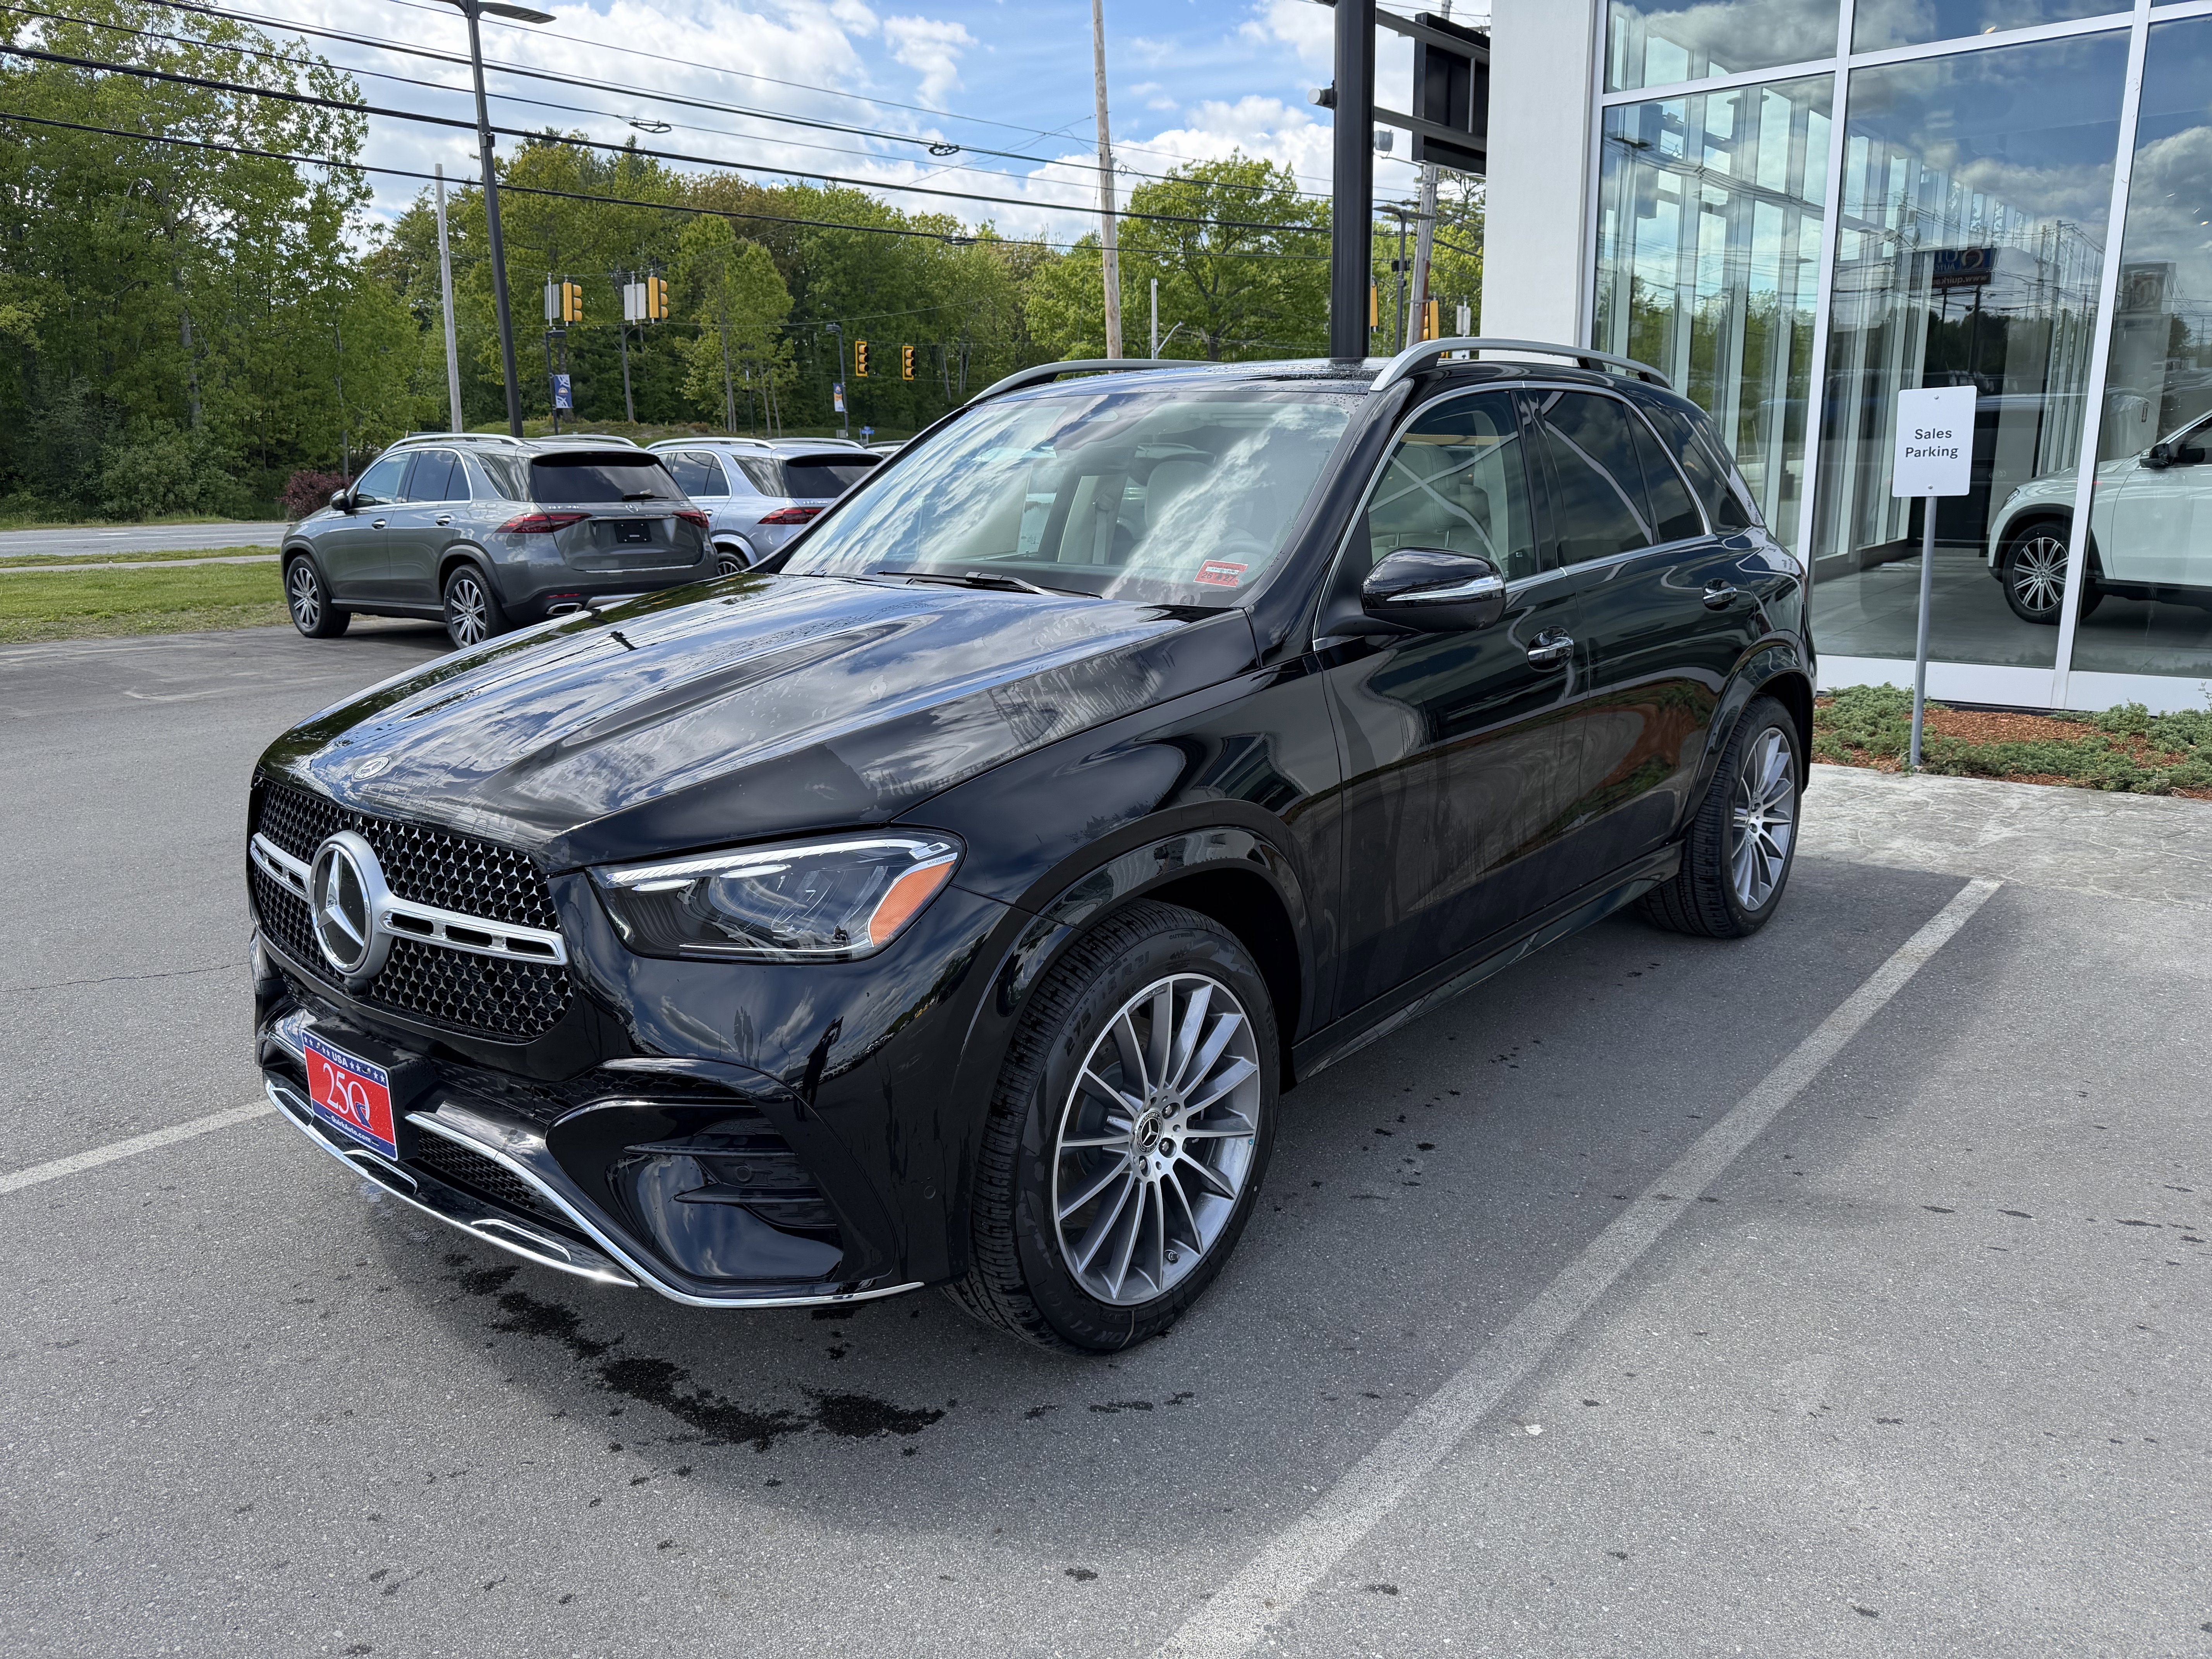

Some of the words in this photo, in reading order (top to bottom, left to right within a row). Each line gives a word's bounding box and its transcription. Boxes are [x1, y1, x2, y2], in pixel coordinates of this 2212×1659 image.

[1915, 428, 1952, 440] Sales
[1905, 446, 1959, 459] Parking
[331, 1051, 349, 1068] USA
[331, 1115, 371, 1144] QuirkAuto.com
